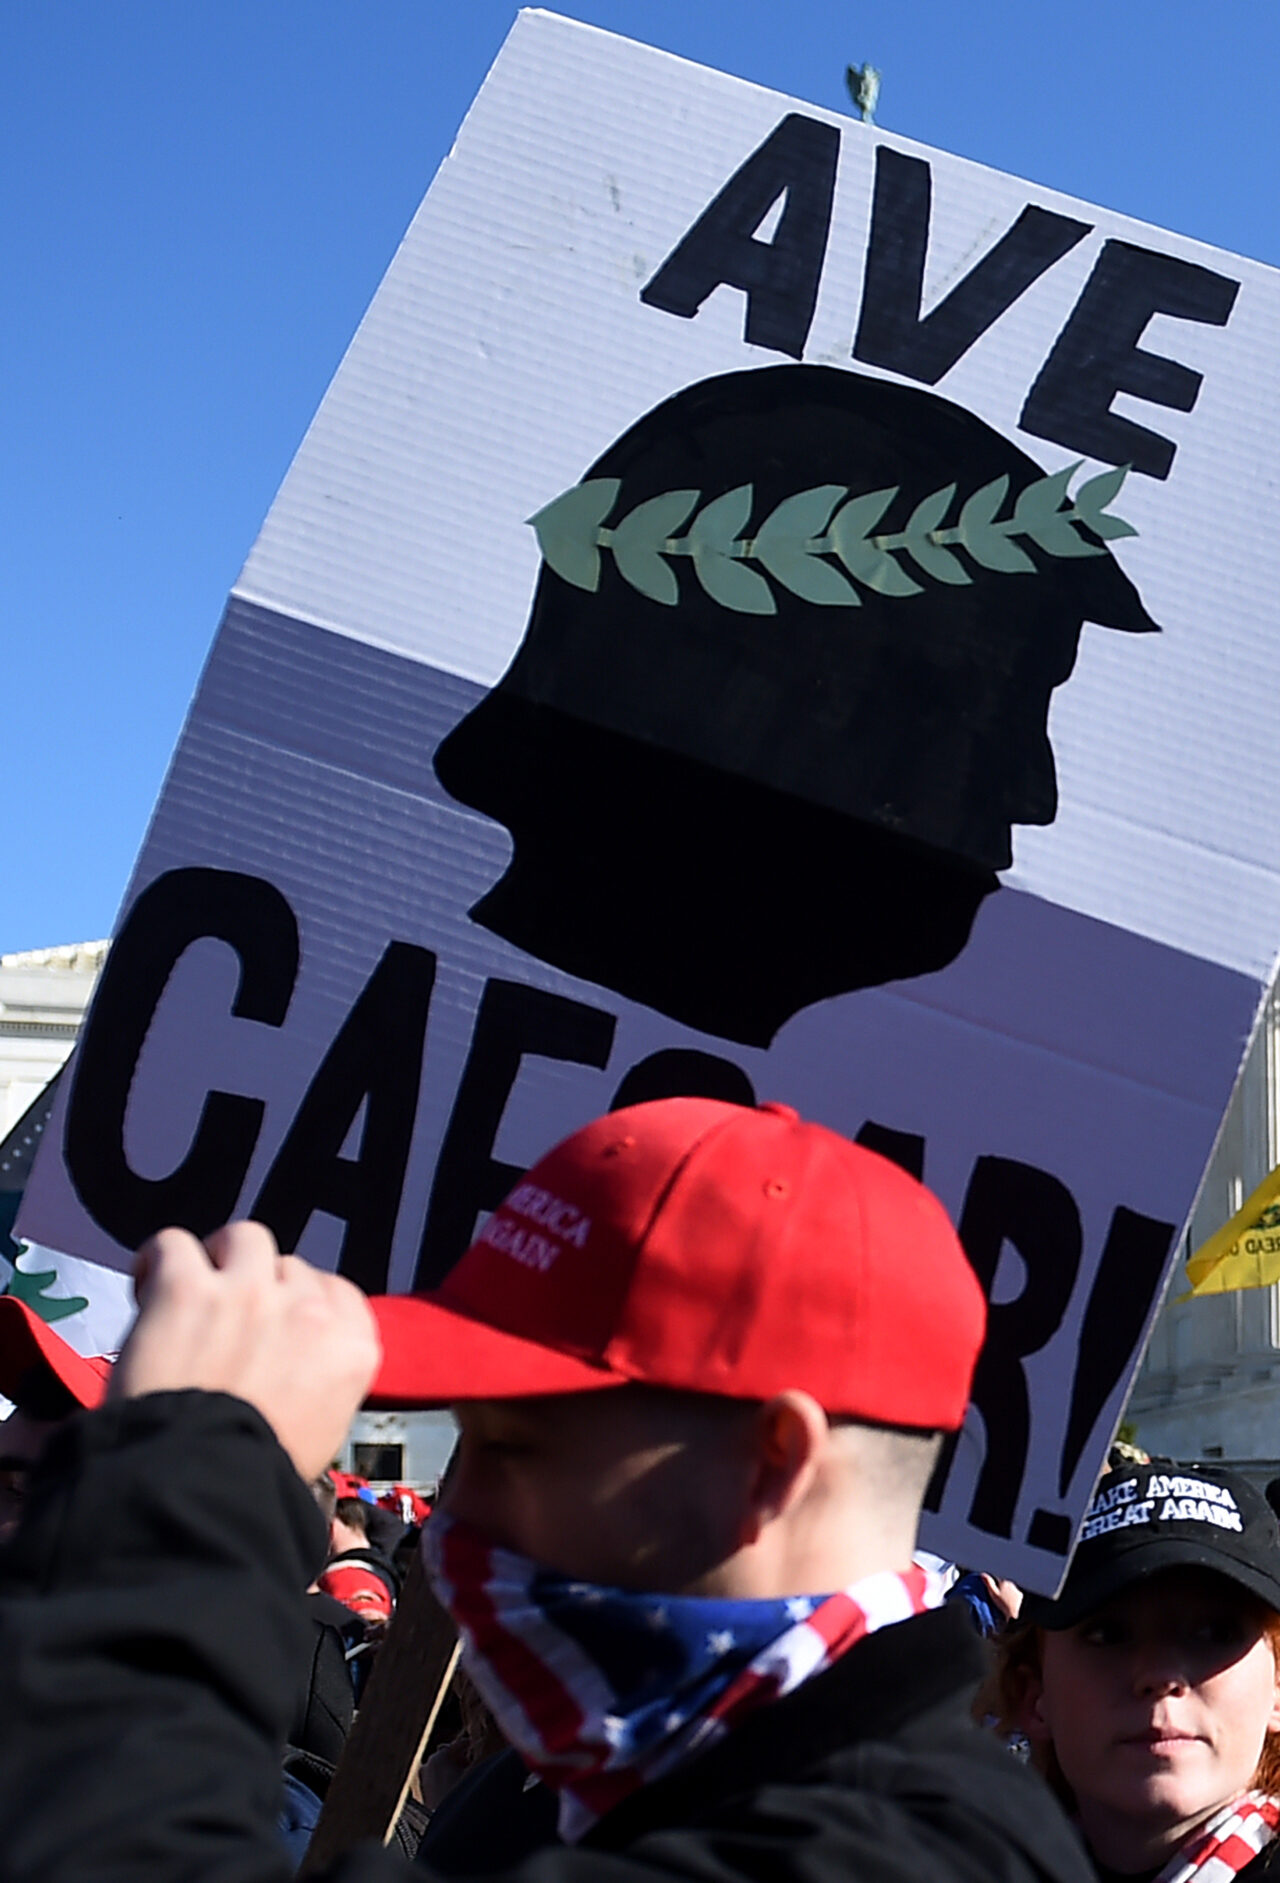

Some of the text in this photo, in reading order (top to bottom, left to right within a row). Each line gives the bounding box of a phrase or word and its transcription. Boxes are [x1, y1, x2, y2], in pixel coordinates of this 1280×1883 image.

[640, 112, 1241, 481] AVE
[506, 1183, 592, 1249] ERICA
[1086, 1475, 1237, 1516] AKE AMERICA
[1159, 1498, 1243, 1532] AGAIN
